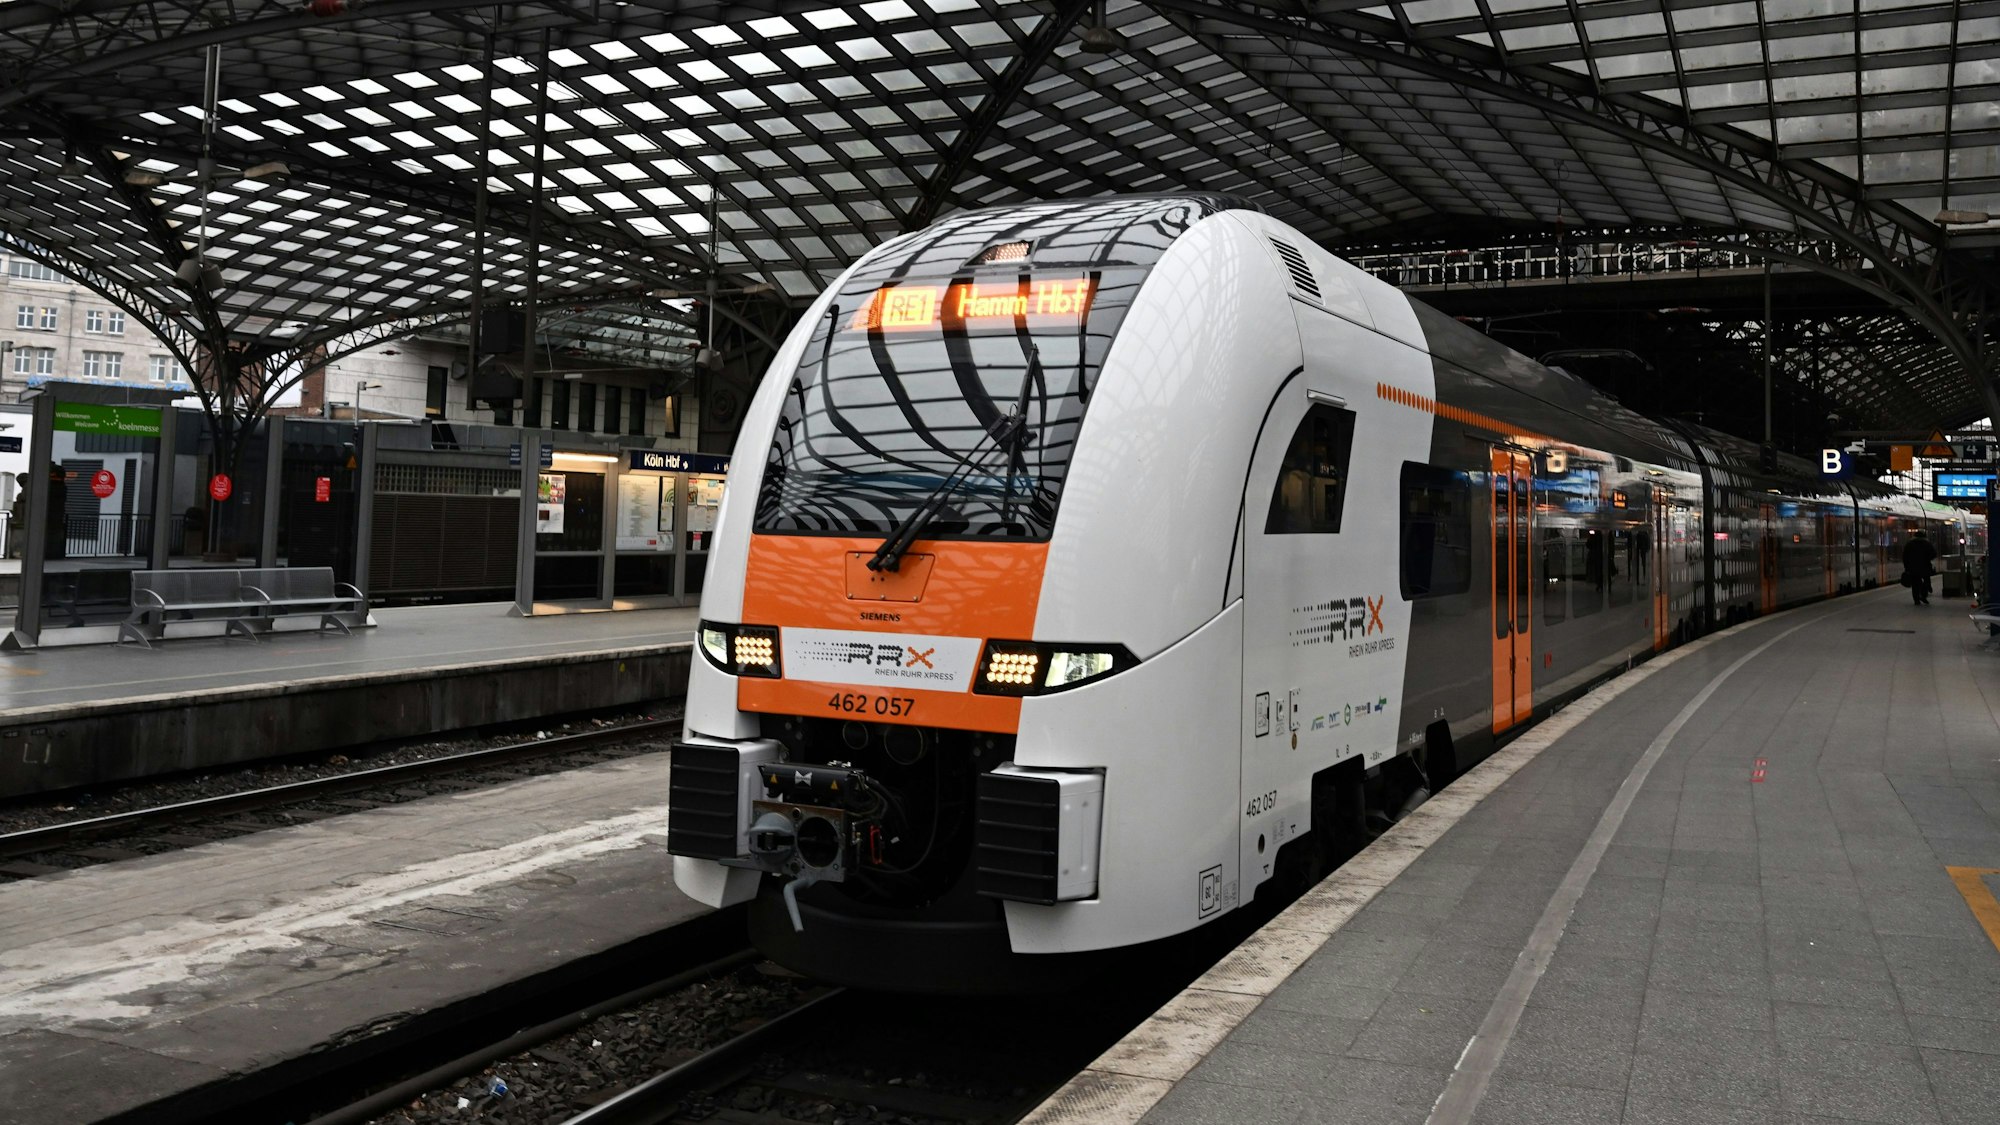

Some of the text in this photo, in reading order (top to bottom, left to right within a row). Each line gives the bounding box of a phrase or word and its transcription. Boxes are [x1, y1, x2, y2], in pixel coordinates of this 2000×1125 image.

[890, 282, 1087, 323] RE1 Hamm Hbf
[118, 421, 160, 433] koelnmesse
[644, 453, 680, 469] Köln Hbf
[1822, 448, 1842, 474] B
[860, 612, 901, 622] SIEMENS
[1330, 594, 1384, 644] RRX
[847, 642, 935, 669] RRX
[1348, 637, 1395, 659] RHEIN RUHR XPRESS
[875, 668, 954, 681] RHEIN RUHR XPRESS
[828, 693, 915, 717] 462 057
[1246, 790, 1278, 818] 462 057
